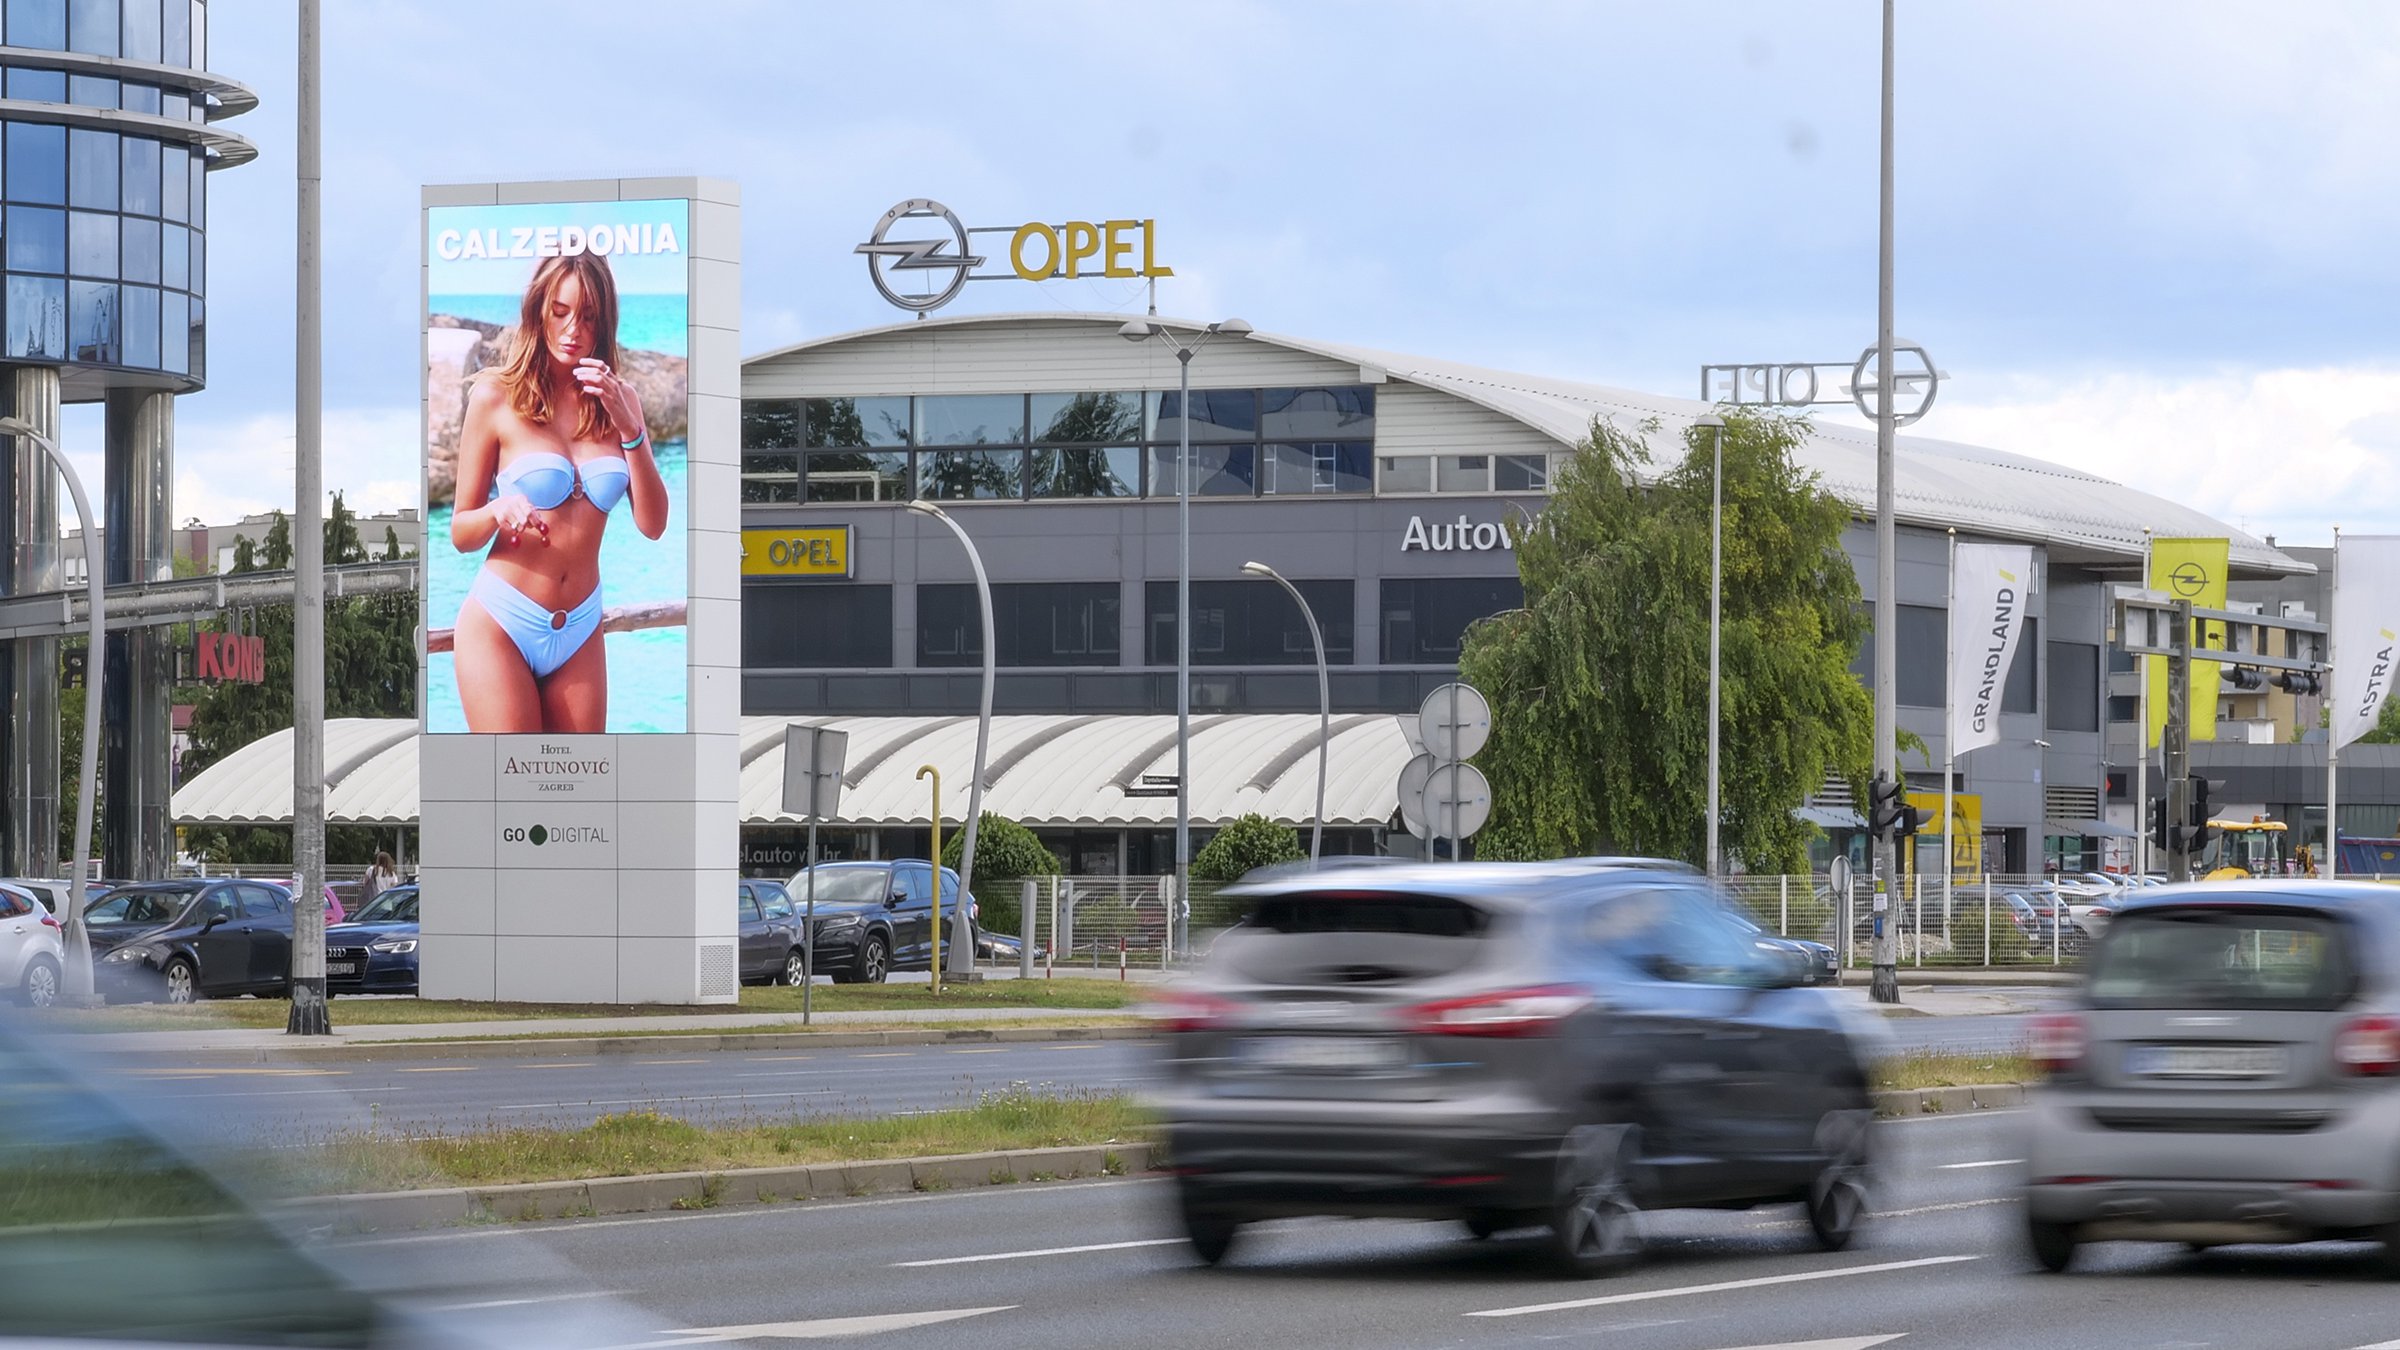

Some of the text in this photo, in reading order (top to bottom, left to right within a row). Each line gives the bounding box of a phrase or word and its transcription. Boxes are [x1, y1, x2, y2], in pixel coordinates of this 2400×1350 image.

[888, 200, 949, 218] OPEL
[436, 223, 679, 260] CALZEDONIA
[1010, 219, 1175, 282] OPEL
[769, 538, 839, 566] OPEL
[1973, 588, 2014, 733] GRANDLAND
[2360, 646, 2393, 717] ASTRA
[503, 827, 609, 842] GO DIGITAL
